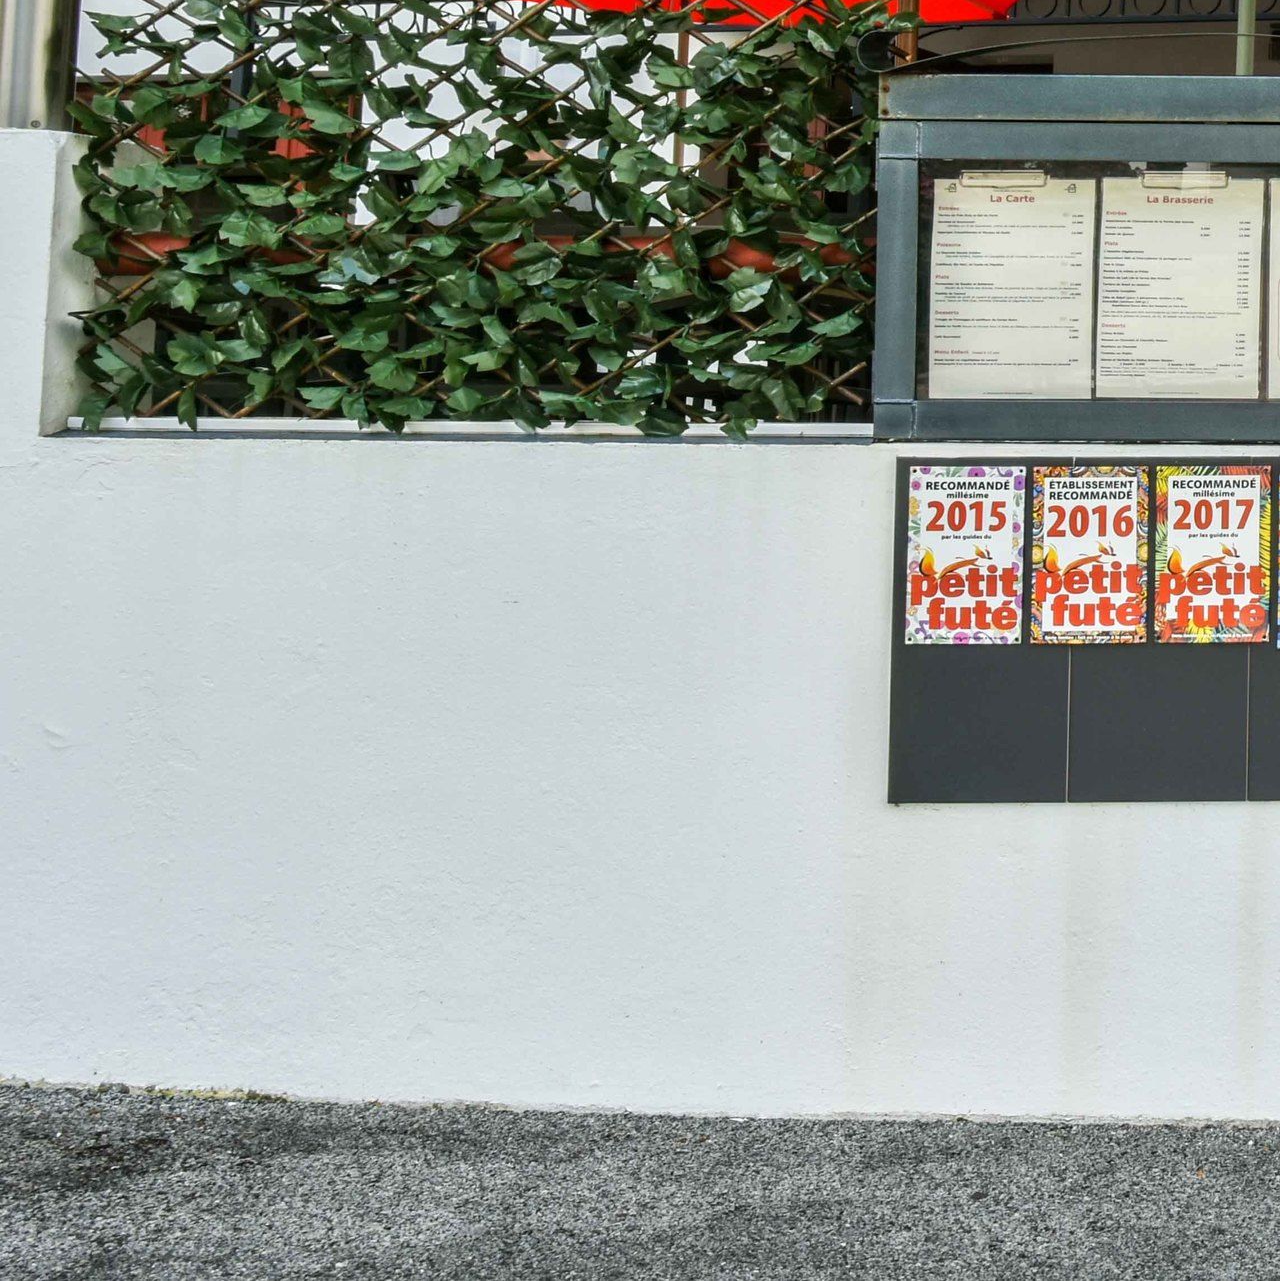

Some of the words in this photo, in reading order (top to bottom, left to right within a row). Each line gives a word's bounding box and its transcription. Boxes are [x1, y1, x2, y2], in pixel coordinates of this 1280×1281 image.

[990, 194, 1002, 203] La
[1005, 194, 1035, 203] Carte
[1147, 195, 1159, 203] La
[1162, 195, 1214, 204] Brasserie
[926, 480, 1010, 490] RECOMMANDÉ
[1049, 480, 1134, 489] ÉTABLISSEMENT
[1049, 490, 1132, 500] RECOMMANDÉ
[1172, 479, 1256, 489] RECOMMANDÉ
[926, 500, 1006, 532] 2015
[1047, 505, 1134, 538] 2016
[1173, 499, 1254, 530] 2017
[910, 564, 1019, 606] petit
[1035, 561, 1143, 603] petit
[1159, 562, 1267, 604] petit
[927, 597, 1018, 631] futé
[1051, 594, 1143, 627] futé
[1175, 596, 1266, 629] futé
